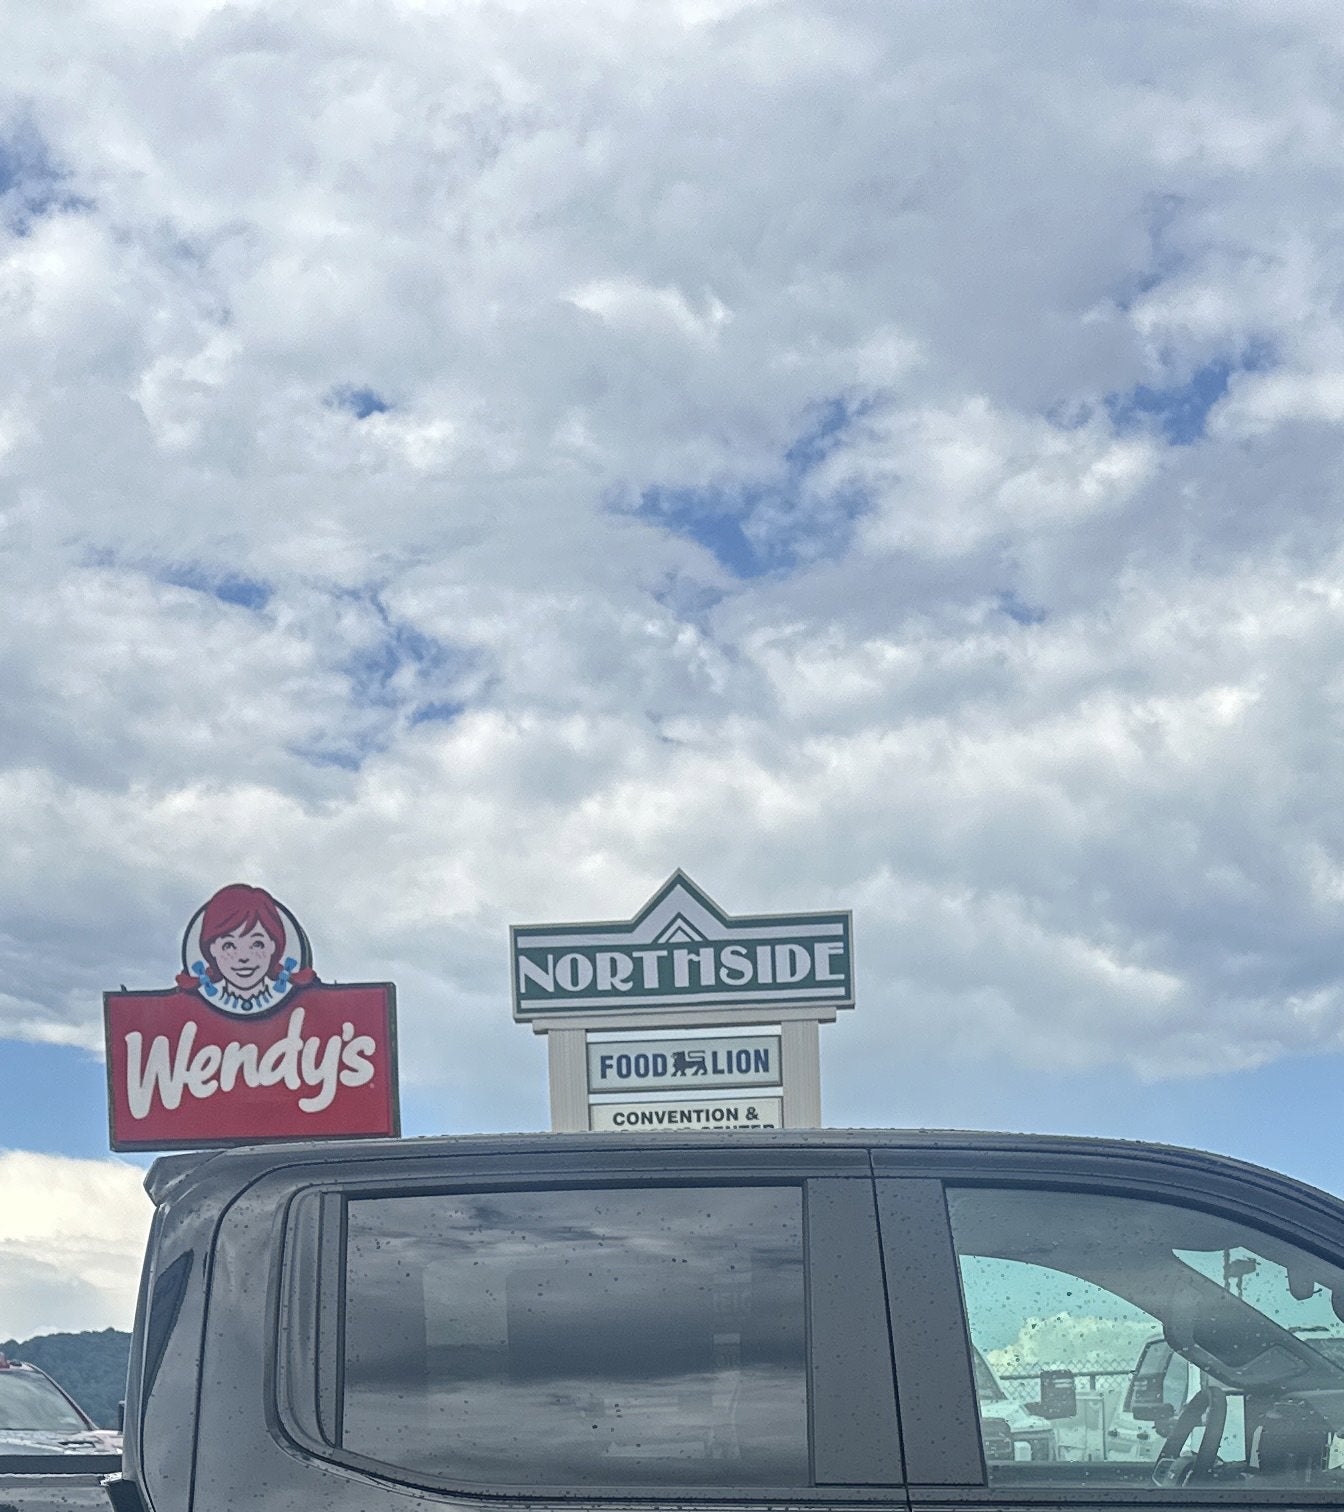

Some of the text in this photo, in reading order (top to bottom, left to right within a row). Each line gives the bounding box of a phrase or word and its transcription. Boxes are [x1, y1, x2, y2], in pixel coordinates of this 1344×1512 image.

[518, 942, 845, 993] NORTHSIDE
[124, 1006, 376, 1120] Wendy's
[599, 1048, 770, 1079] FOOD LION
[612, 1106, 759, 1126] CONVENTION &
